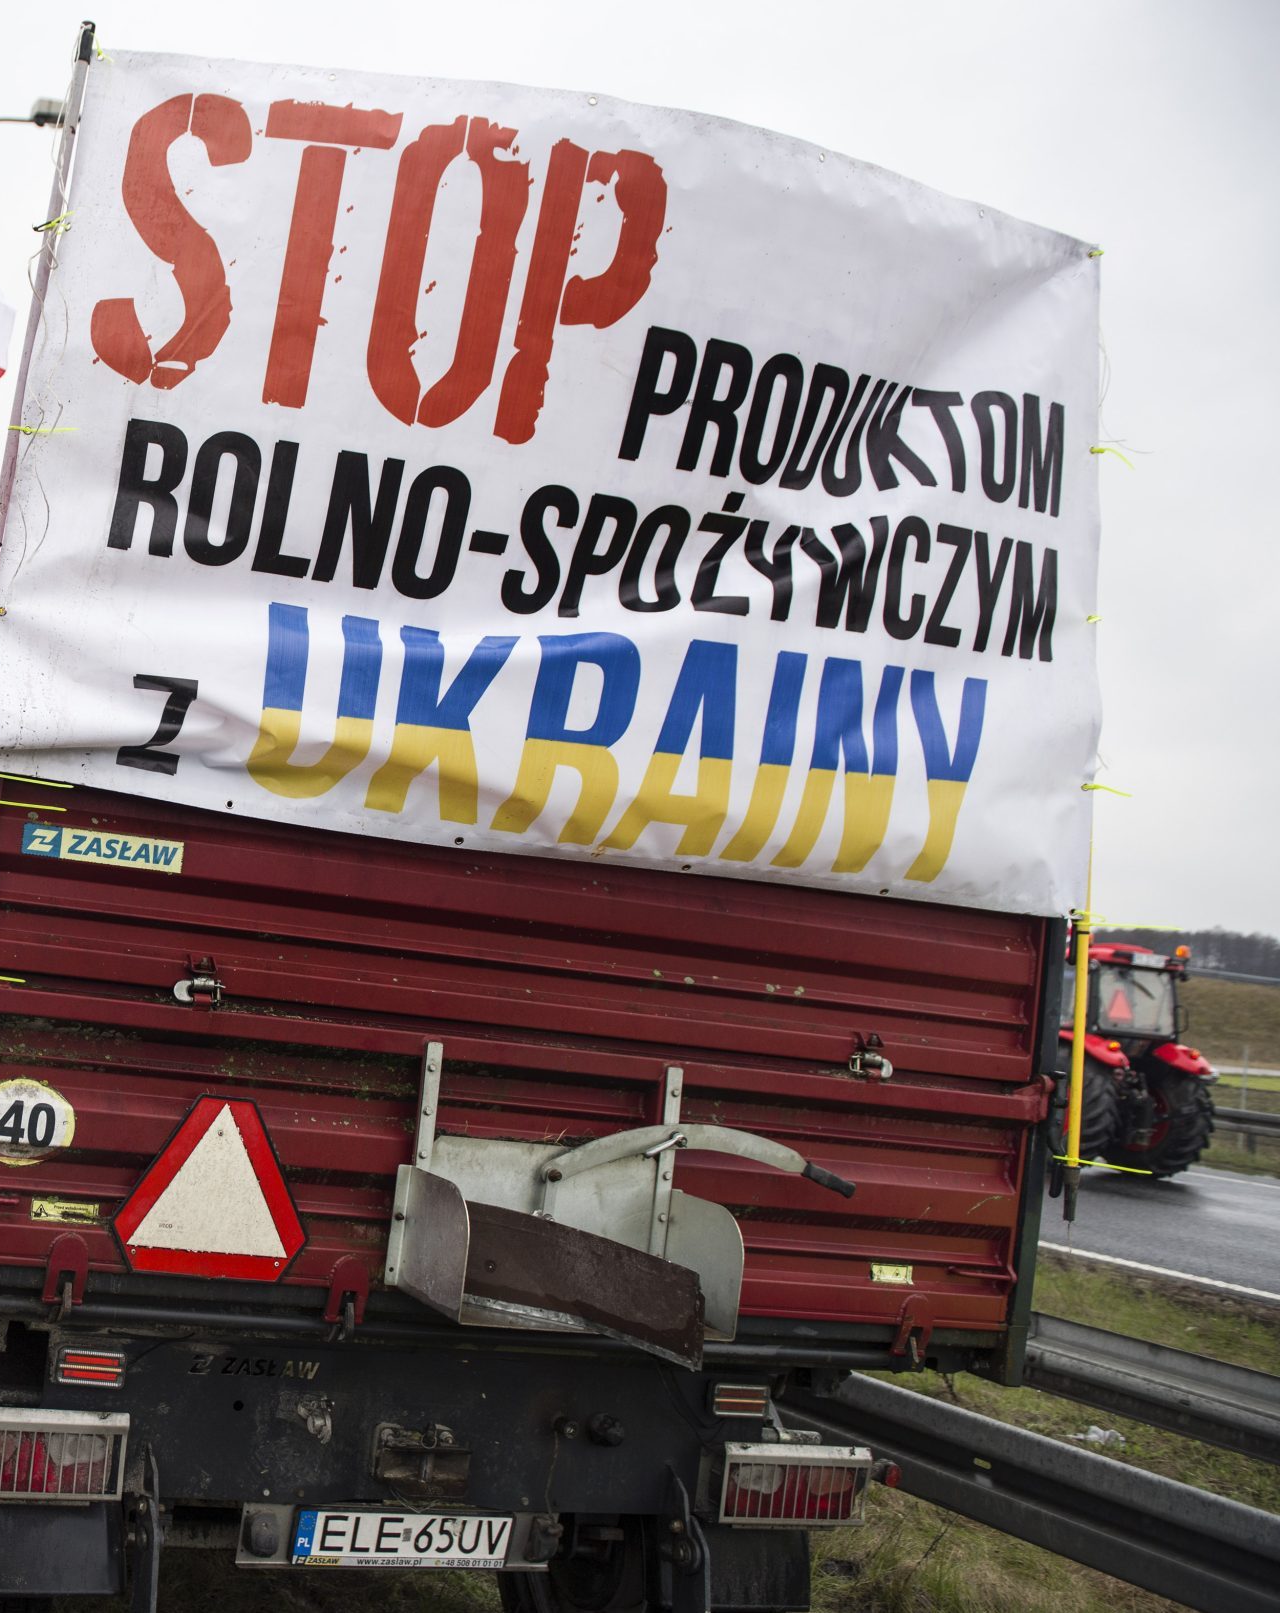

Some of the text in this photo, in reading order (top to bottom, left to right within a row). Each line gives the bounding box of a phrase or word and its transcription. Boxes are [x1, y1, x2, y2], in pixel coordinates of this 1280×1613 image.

[91, 92, 668, 445] STOP
[618, 325, 1065, 518] PRODUKTOM
[107, 418, 1059, 663] ROLNO-SPOŻYWCZYM
[67, 834, 179, 866] ZASŁAW
[247, 601, 987, 883] UKRAINY
[297, 1515, 508, 1556] PL ELE 65UV
